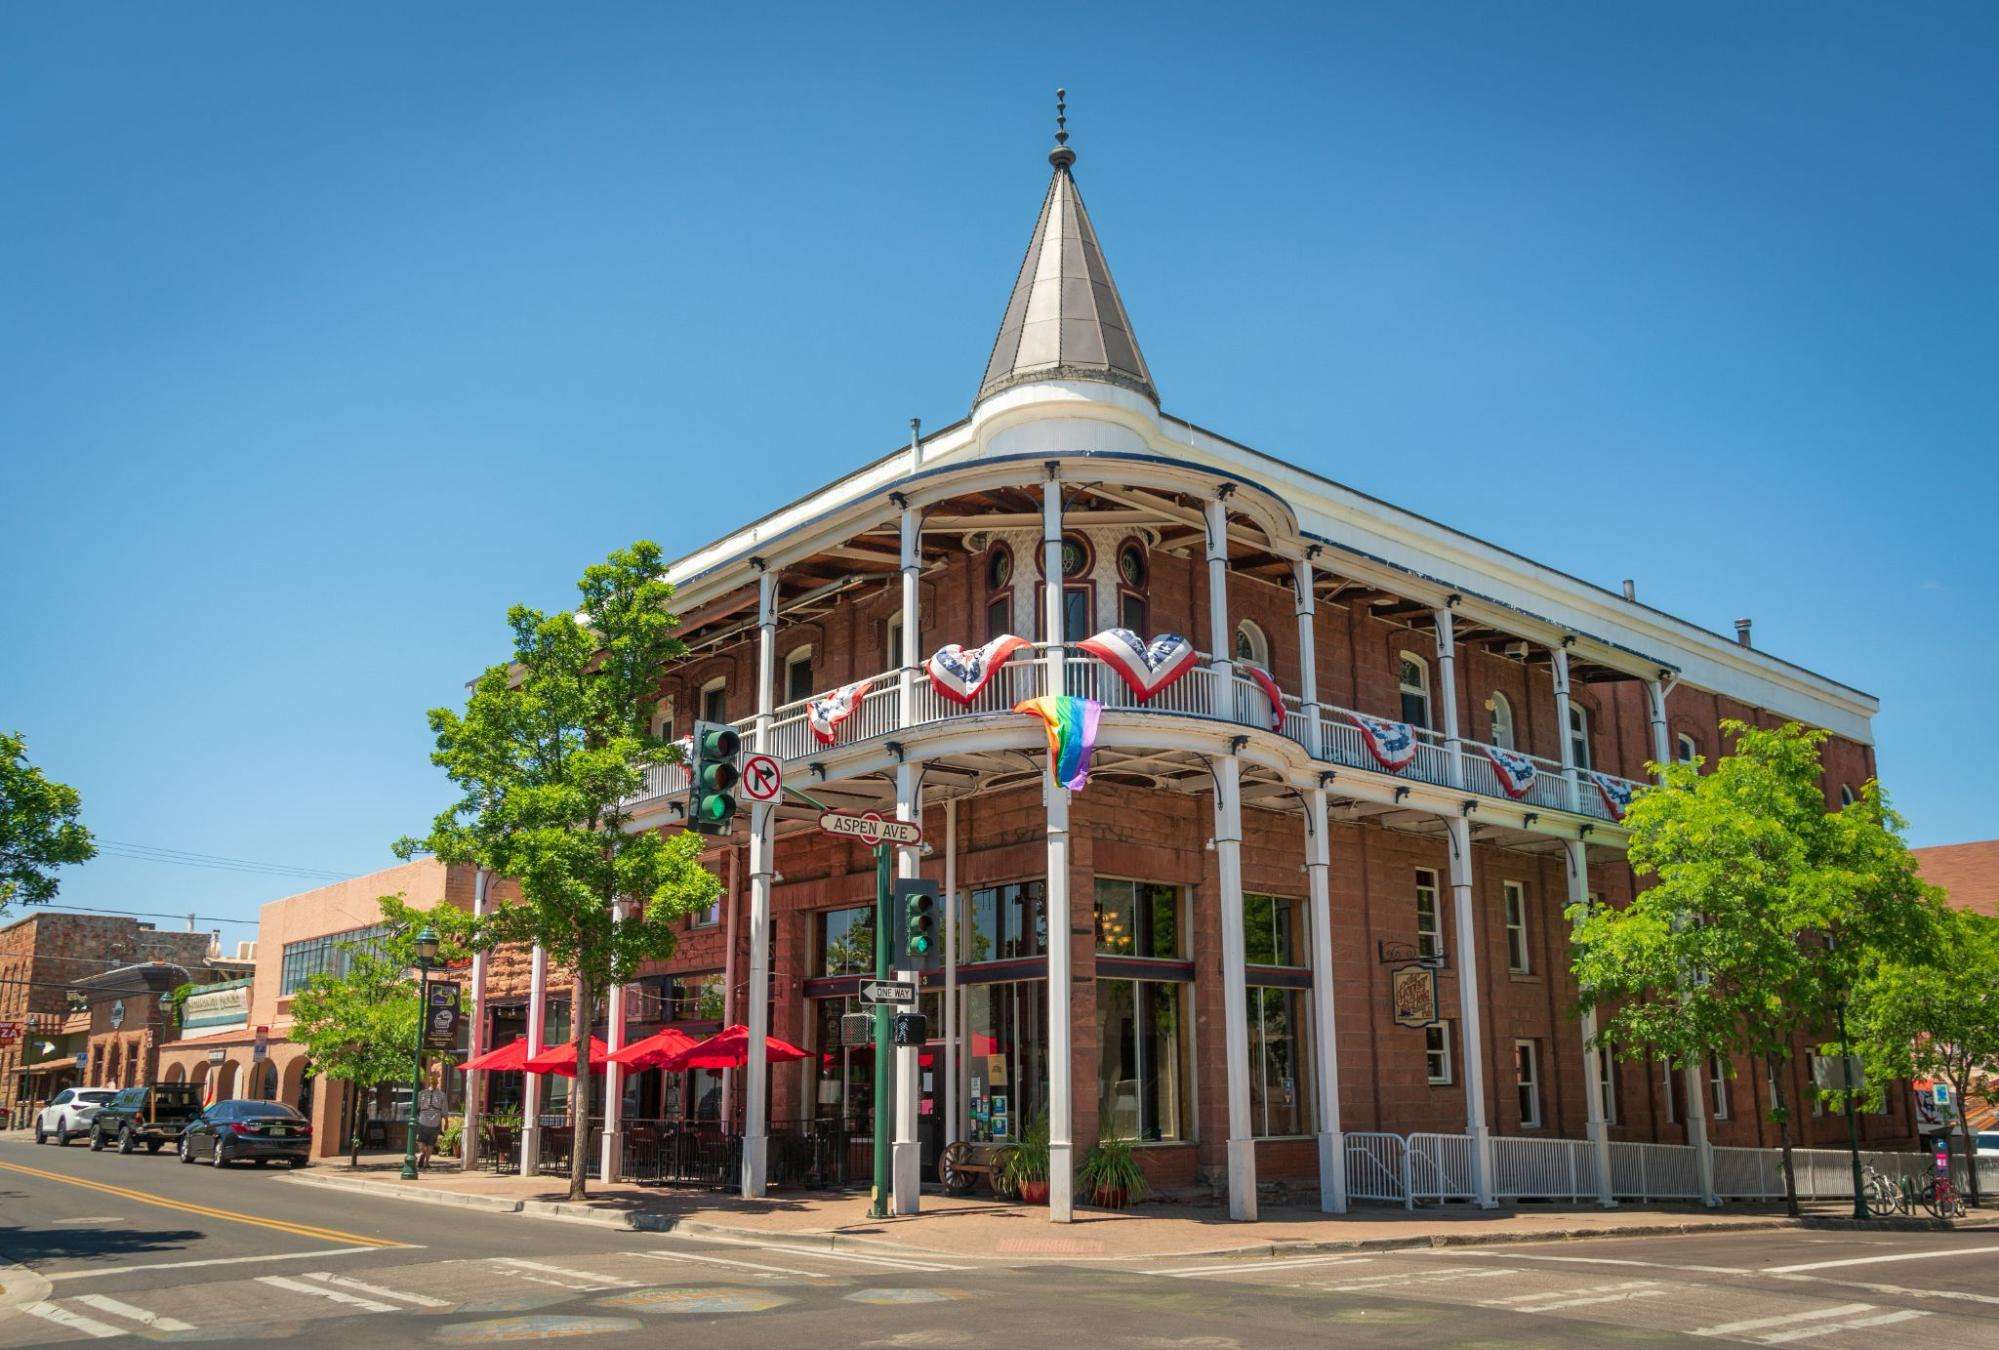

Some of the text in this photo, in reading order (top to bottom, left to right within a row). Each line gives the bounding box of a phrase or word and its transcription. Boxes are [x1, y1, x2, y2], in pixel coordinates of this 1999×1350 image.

[833, 817, 908, 840] ASPEN AVE
[876, 988, 910, 998] ONE WAY
